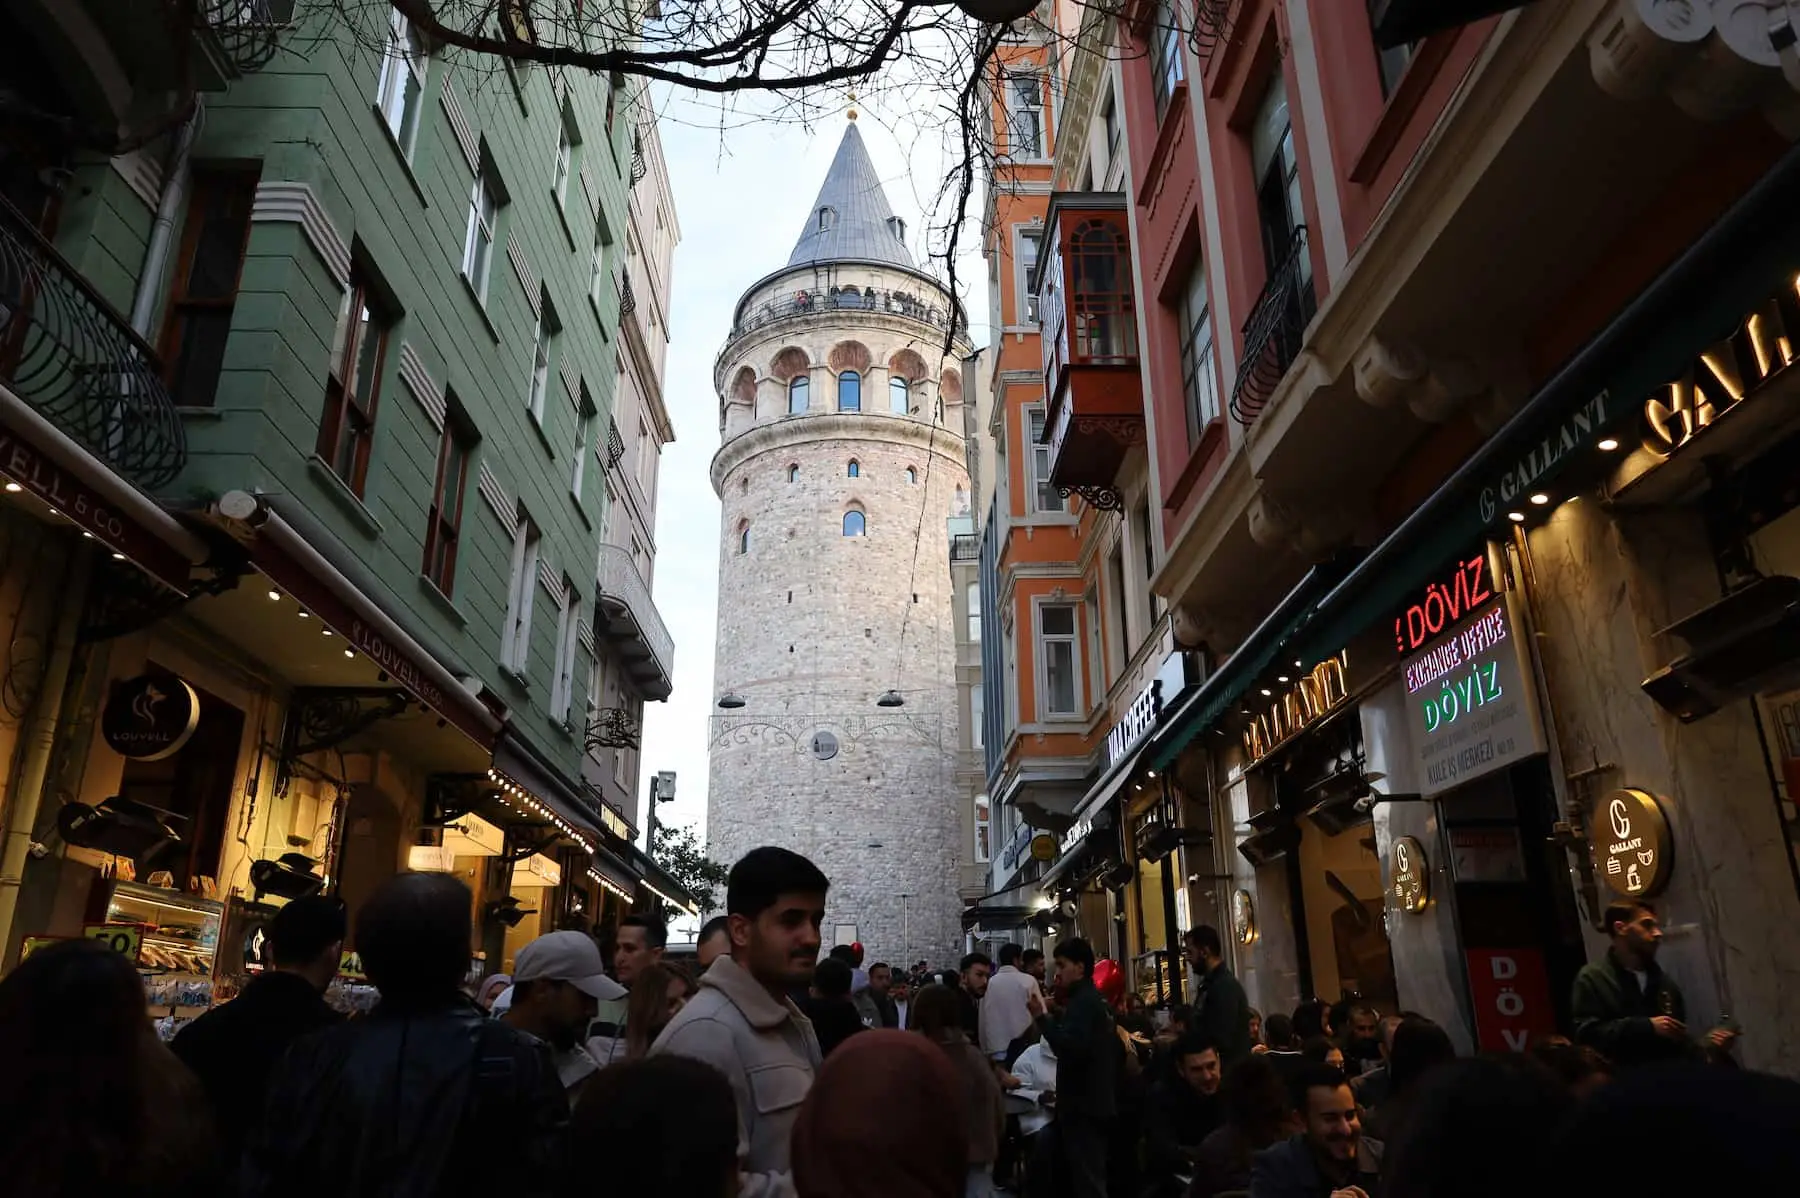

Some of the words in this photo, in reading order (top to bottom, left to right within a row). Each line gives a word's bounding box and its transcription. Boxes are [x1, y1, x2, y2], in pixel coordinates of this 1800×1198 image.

[1500, 387, 1610, 502] GALLANT
[362, 628, 421, 693] LOUVELL
[1407, 637, 1461, 693] EXCHANGE
[1461, 607, 1506, 660] OFFICE
[1124, 680, 1158, 752] COFFEE
[1423, 661, 1503, 732] DÖVİZ
[1427, 760, 1449, 785] KULE
[1609, 837, 1642, 855] GALLANT
